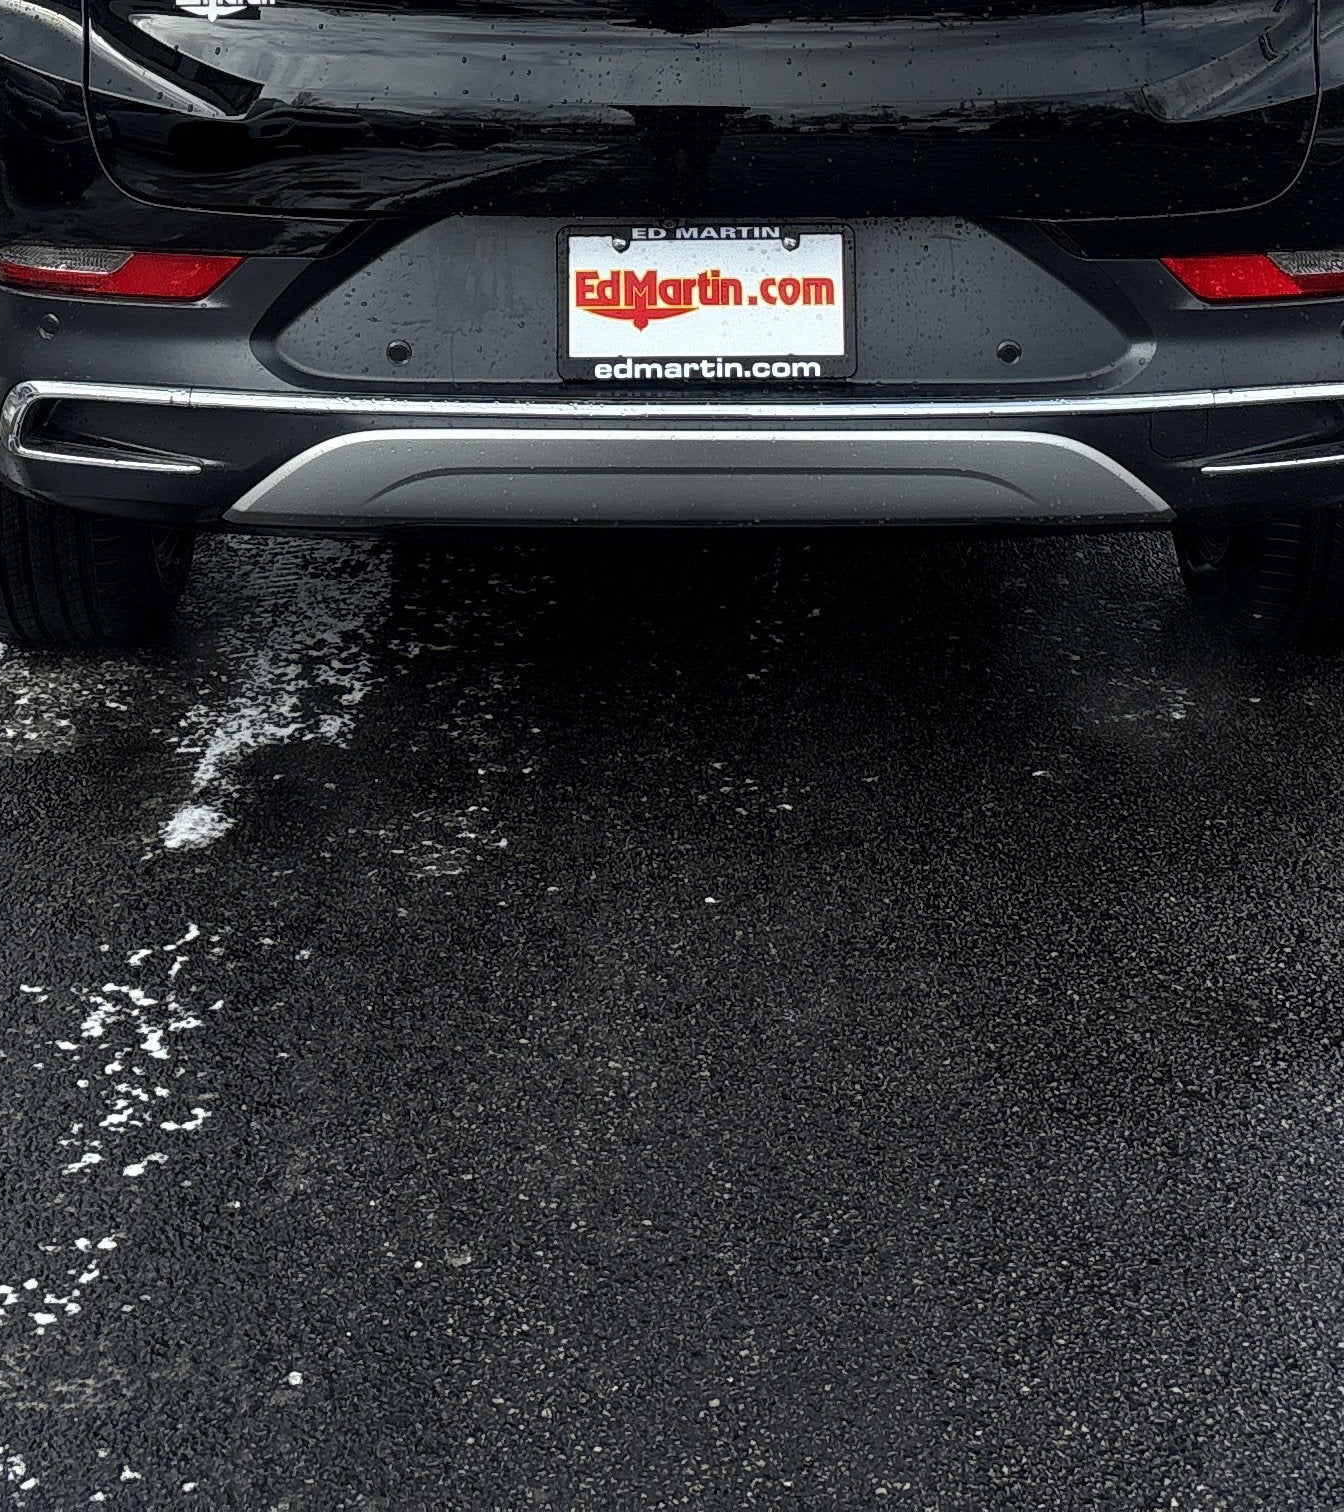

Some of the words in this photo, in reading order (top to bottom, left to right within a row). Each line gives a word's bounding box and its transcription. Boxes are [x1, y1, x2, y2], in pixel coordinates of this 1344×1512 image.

[632, 227, 667, 239] ED
[676, 227, 780, 239] MARTIN
[594, 358, 821, 379] edmartin.com
